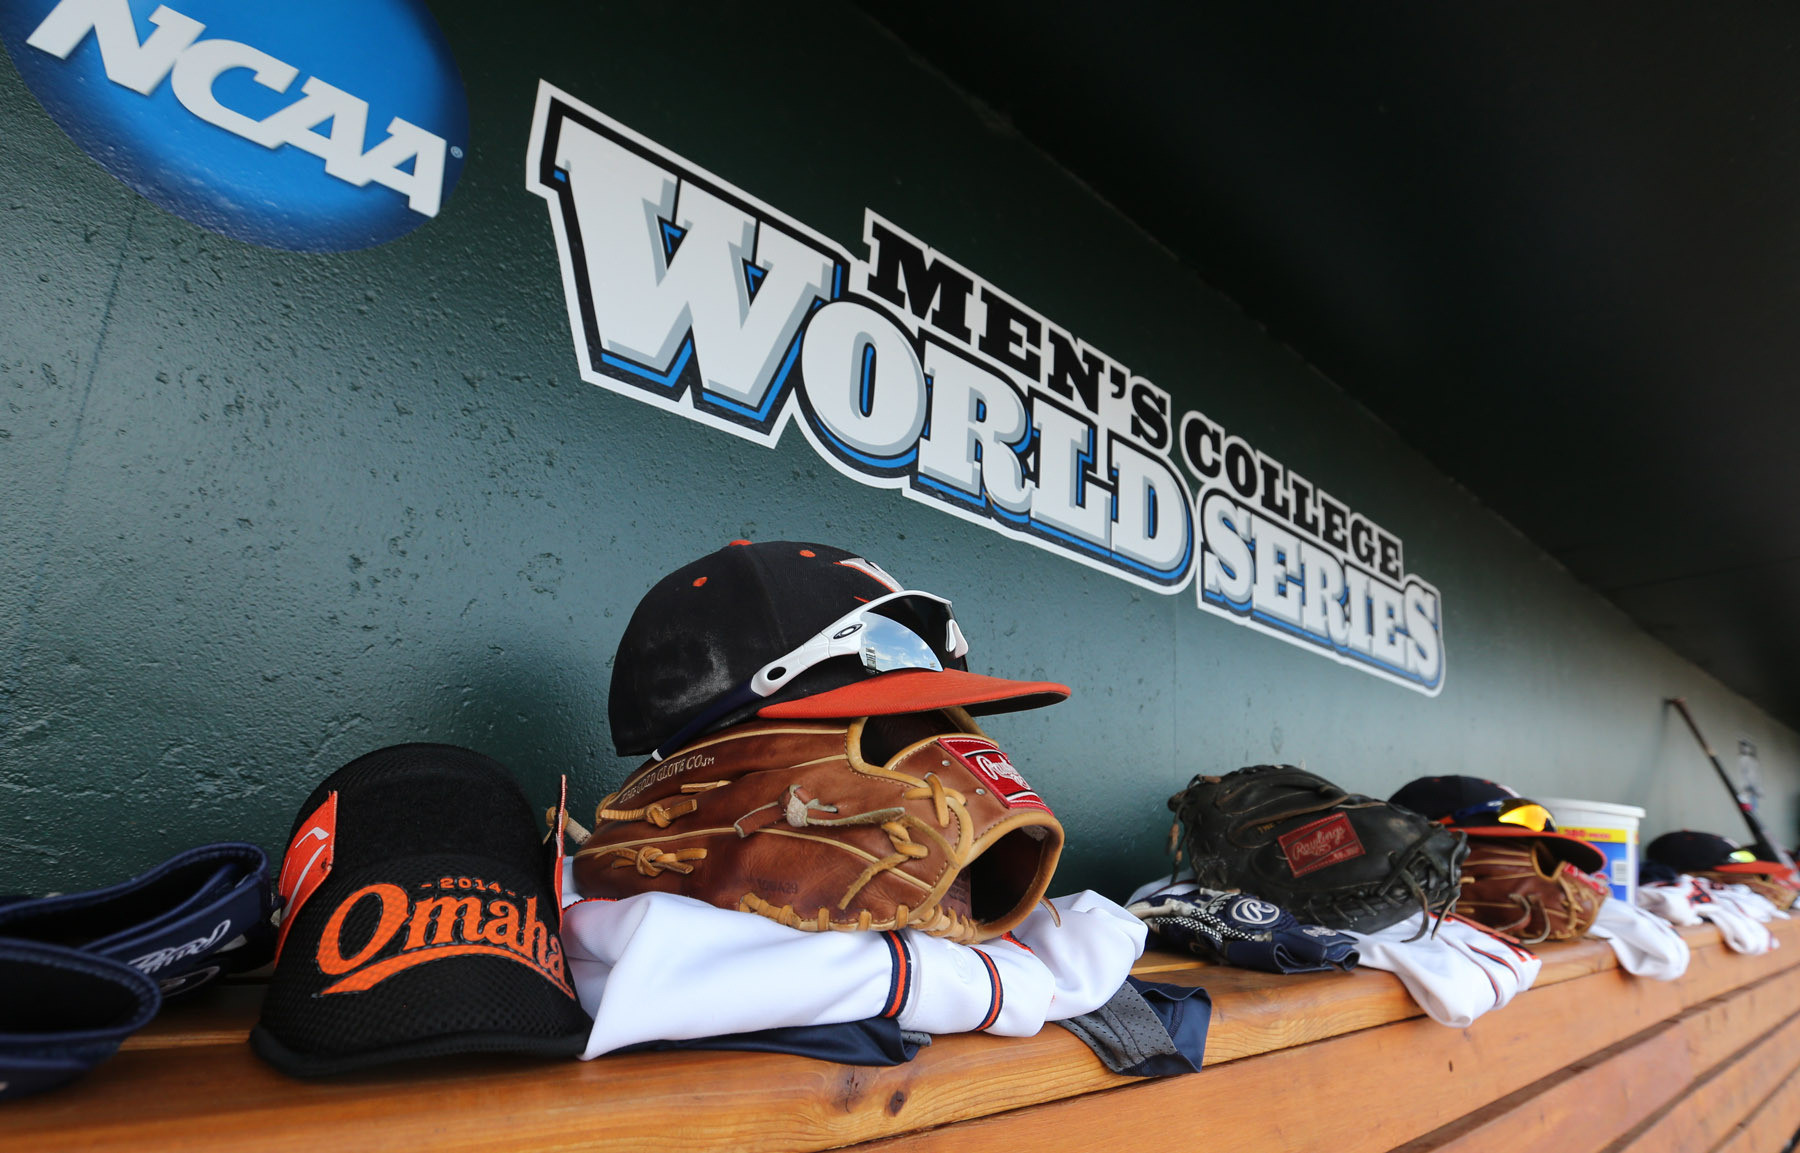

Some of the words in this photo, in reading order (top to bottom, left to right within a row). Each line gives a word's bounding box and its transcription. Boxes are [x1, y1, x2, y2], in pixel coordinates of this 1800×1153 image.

[26, 0, 446, 218] NCAA
[546, 103, 1192, 581] WORLD
[1202, 492, 1441, 684] SERIES
[867, 220, 1169, 450] MEN'S
[1184, 417, 1400, 582] COLLEGE
[656, 758, 686, 782] GLOVE
[440, 877, 501, 894] 2014
[1292, 825, 1346, 861] Rawlings
[315, 883, 566, 985] Omaha
